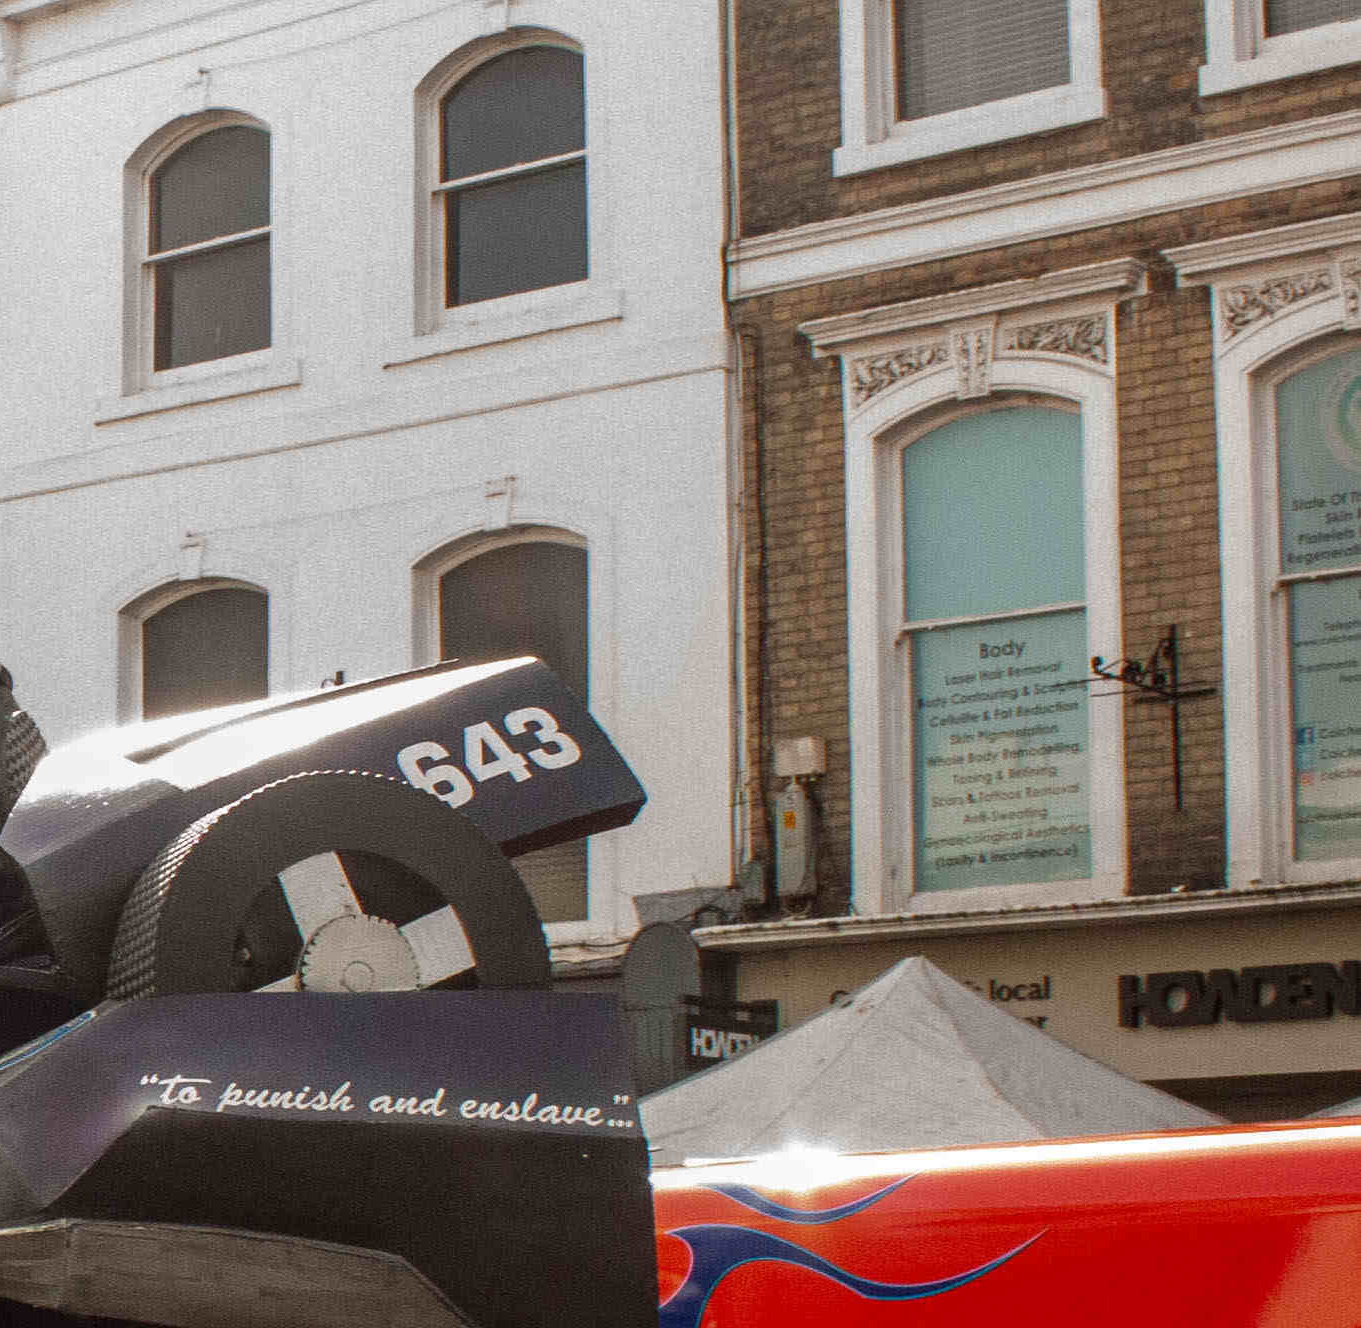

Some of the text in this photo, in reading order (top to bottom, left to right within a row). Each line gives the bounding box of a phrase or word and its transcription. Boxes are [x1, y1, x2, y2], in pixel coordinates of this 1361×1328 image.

[979, 639, 1026, 659] Body
[396, 706, 582, 810] 643
[987, 975, 1051, 1002] local
[217, 1080, 354, 1113] punish
[368, 1087, 446, 1118] and
